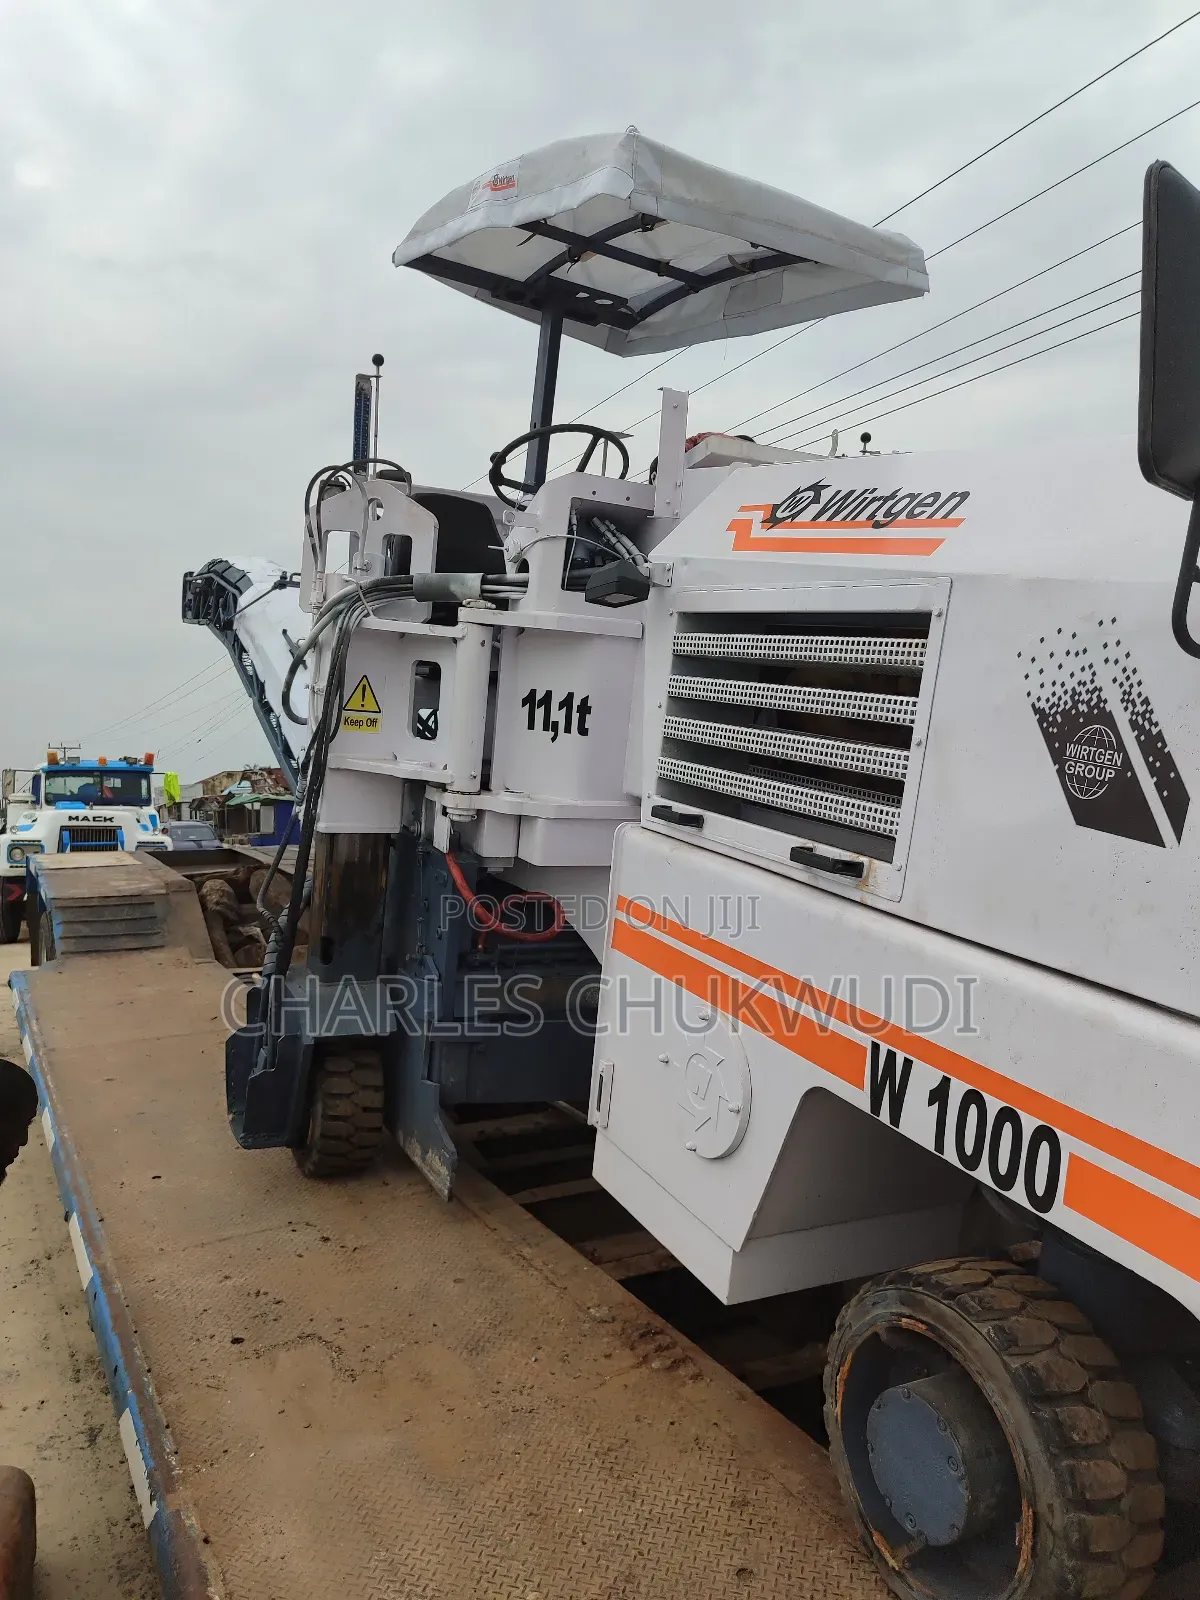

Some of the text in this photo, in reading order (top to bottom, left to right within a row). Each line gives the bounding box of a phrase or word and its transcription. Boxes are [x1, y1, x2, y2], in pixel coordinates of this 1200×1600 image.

[809, 486, 971, 529] Wirtgen
[343, 716, 378, 728] Keep Off
[521, 688, 592, 743] 11,1t
[1066, 742, 1123, 767] WIRTGEN
[1065, 761, 1116, 782] GROUP
[68, 815, 114, 823] MACK
[868, 1041, 1063, 1214] W 1000
